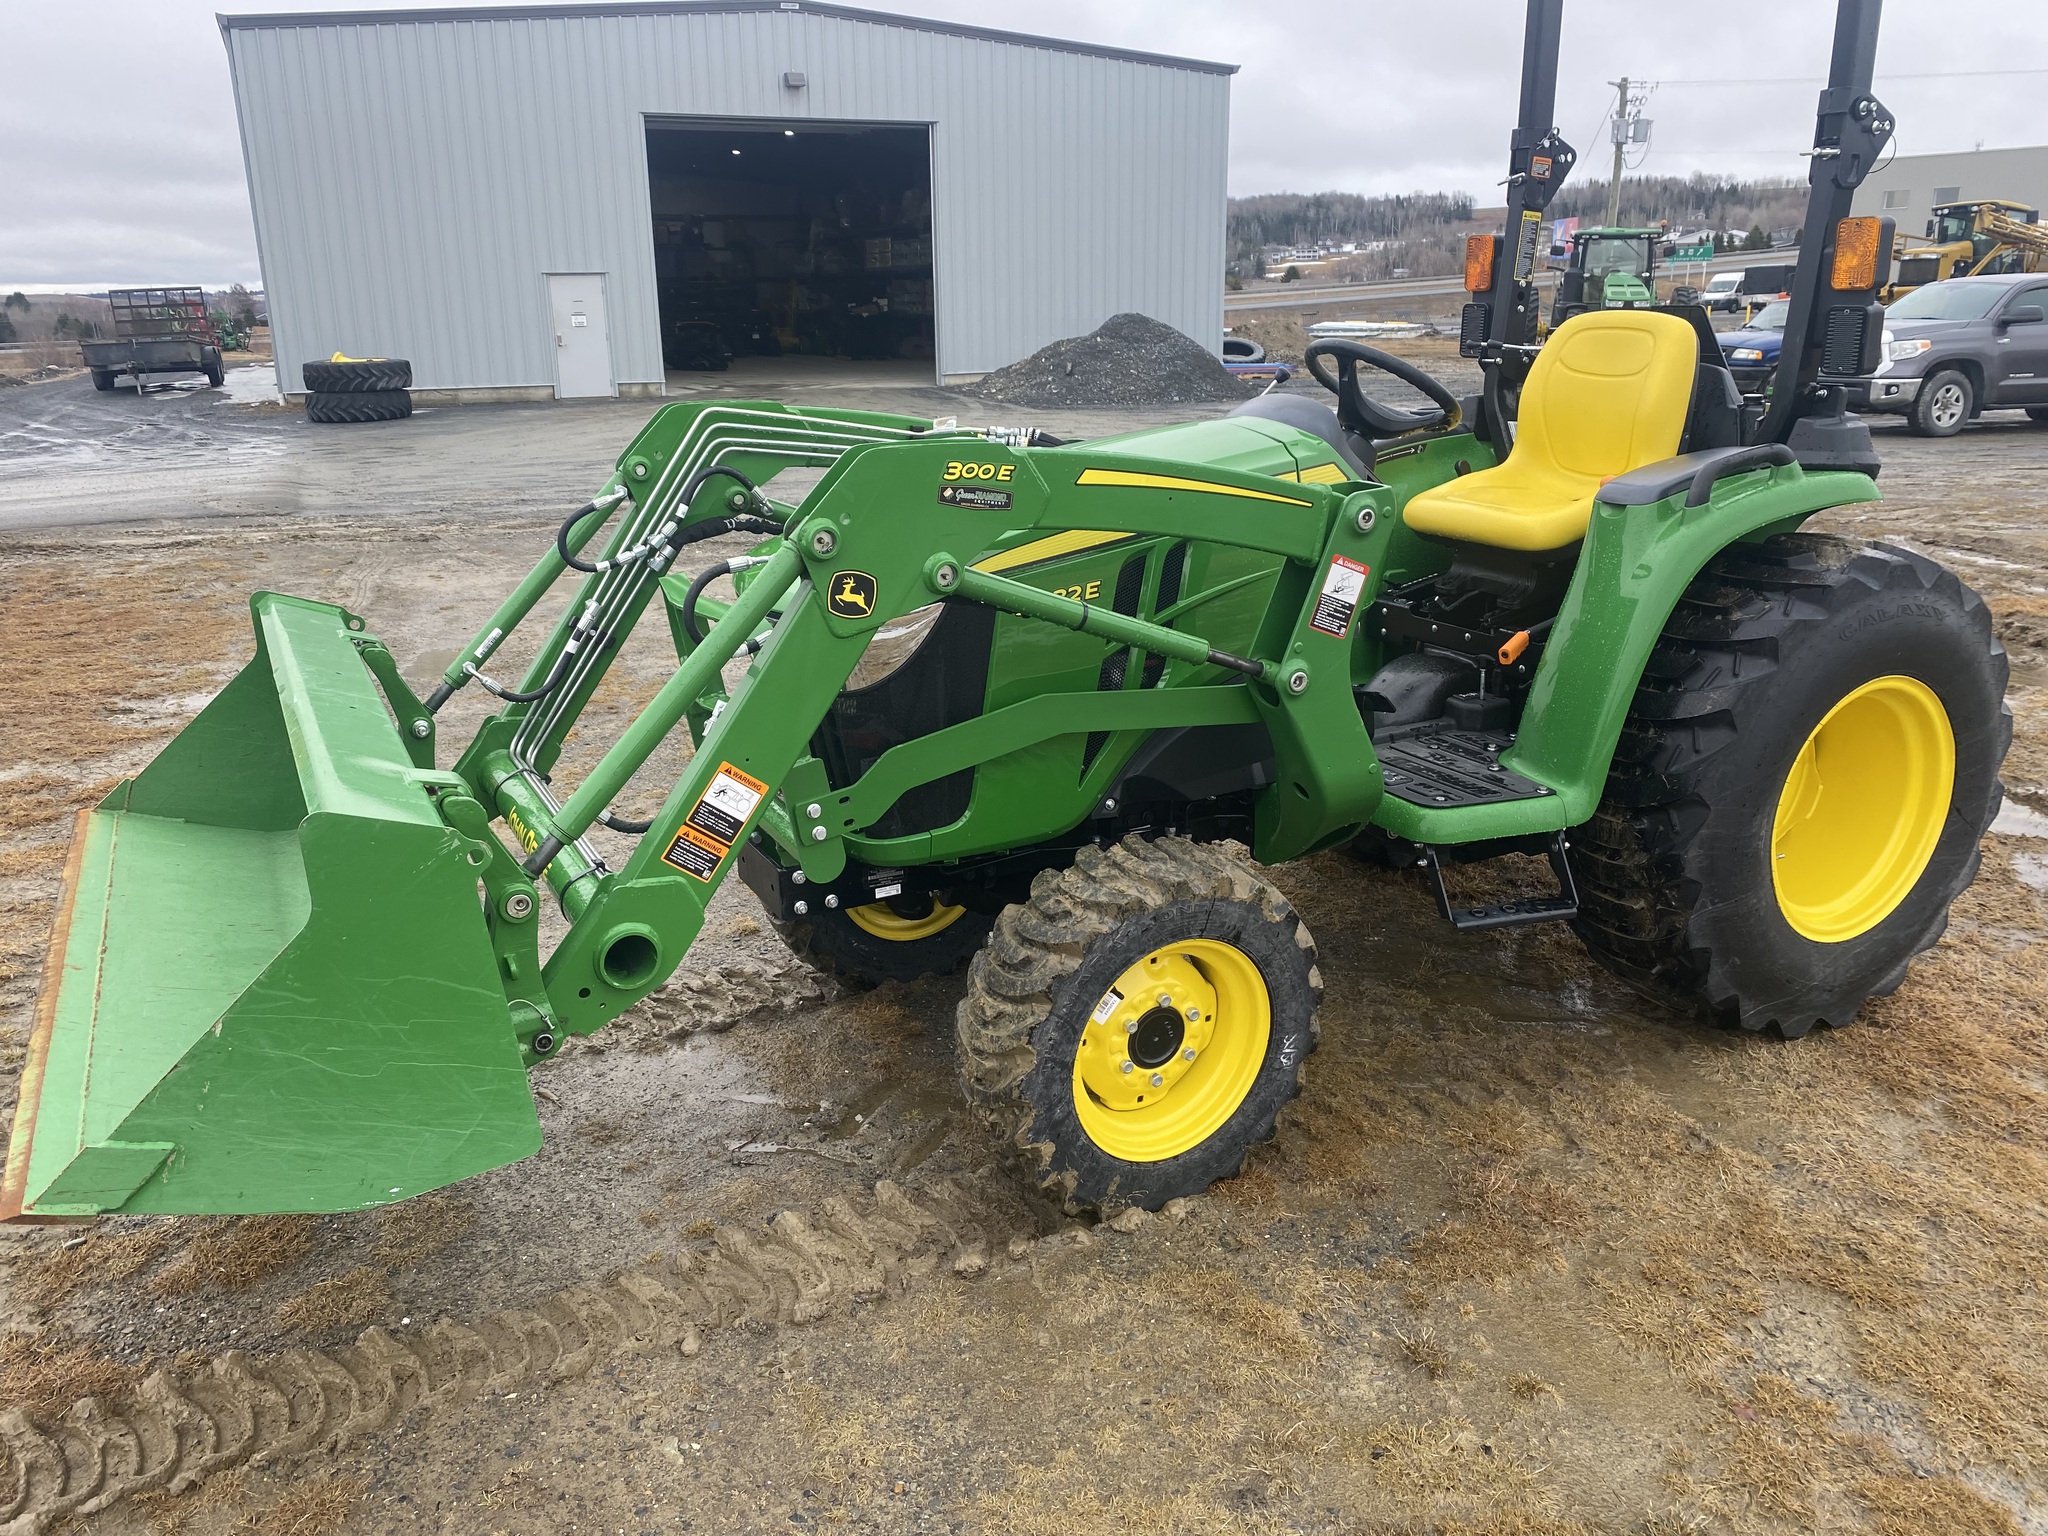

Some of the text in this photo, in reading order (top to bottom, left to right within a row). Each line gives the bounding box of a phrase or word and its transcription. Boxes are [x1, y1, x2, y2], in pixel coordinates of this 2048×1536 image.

[1344, 561, 1365, 572] DANGER
[1839, 603, 1945, 641] GALAXY
[733, 771, 762, 791] WARNING
[508, 806, 527, 846] JOHN
[692, 834, 722, 854] WARNING
